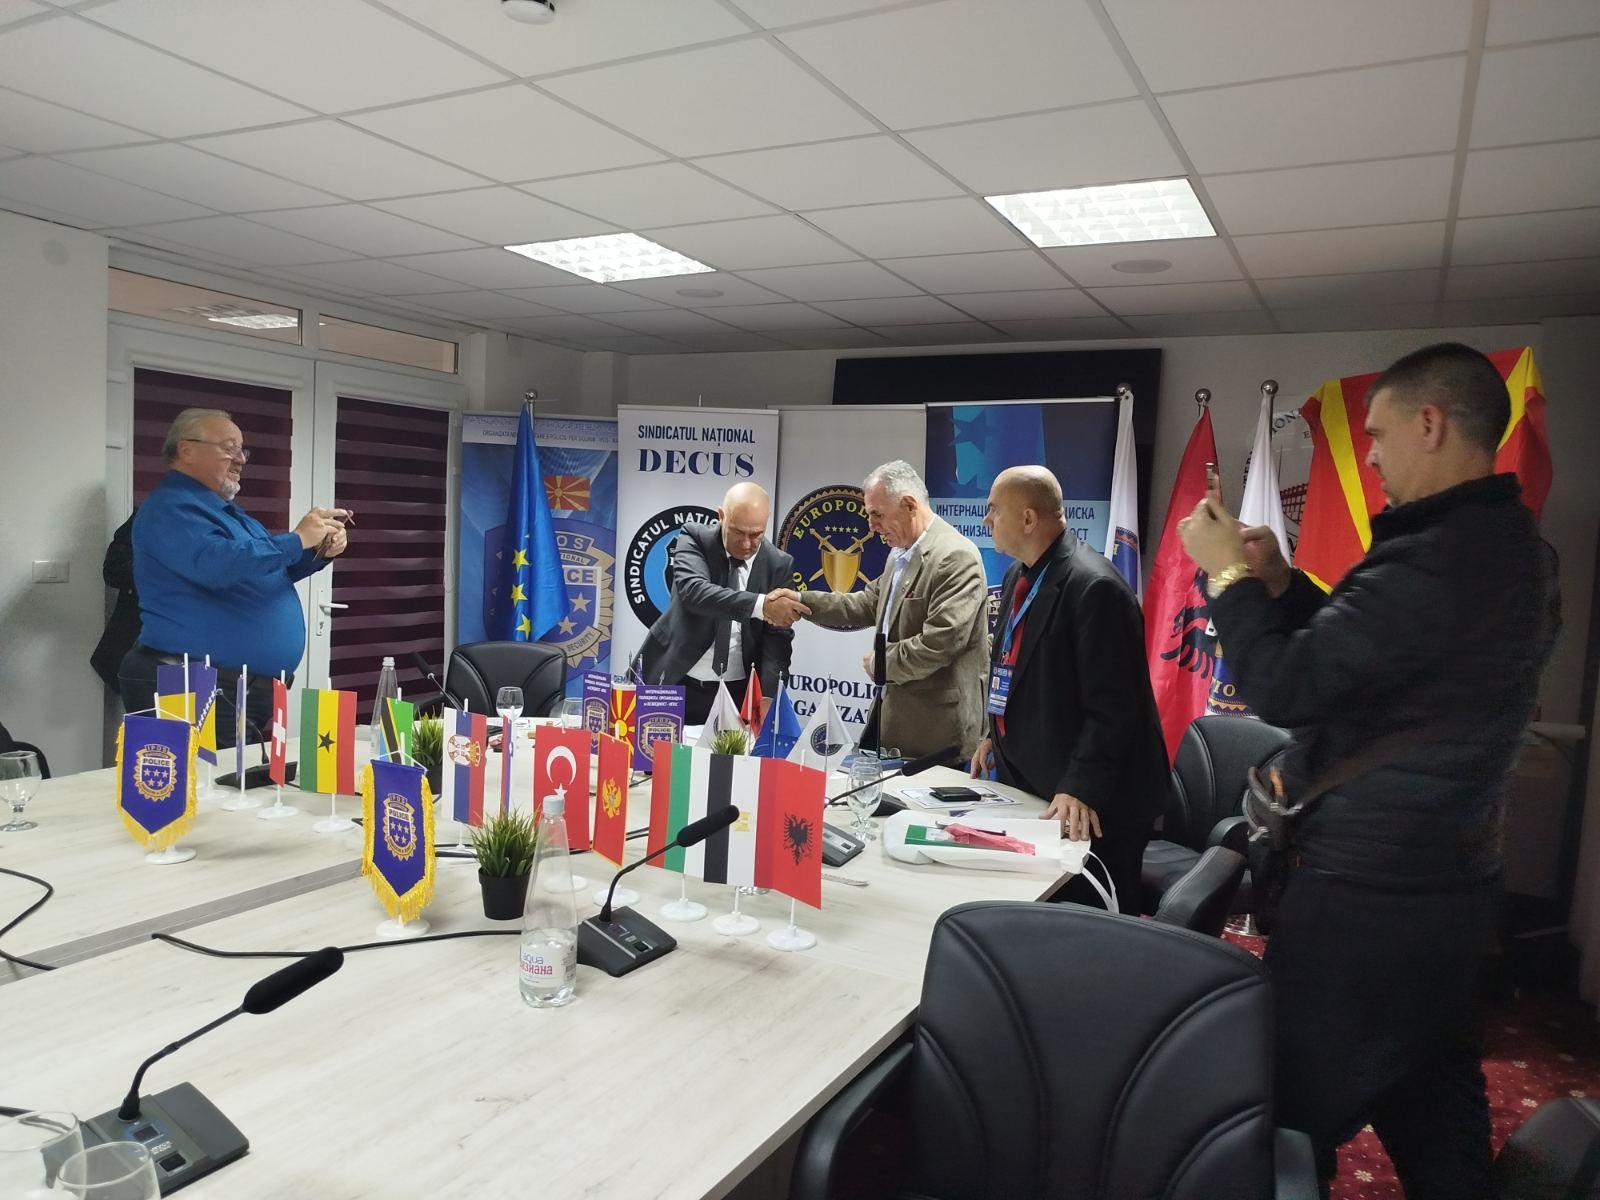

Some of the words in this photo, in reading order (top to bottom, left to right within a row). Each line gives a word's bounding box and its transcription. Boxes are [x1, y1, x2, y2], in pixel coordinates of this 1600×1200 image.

[638, 424, 698, 441] SINDICATUL
[702, 427, 756, 447] NAȚIONAL
[637, 448, 755, 478] DECUS
[556, 535, 584, 549] OS
[630, 519, 670, 604] SINDICATUL
[674, 512, 721, 527] NATIO
[143, 758, 170, 766] POLICE
